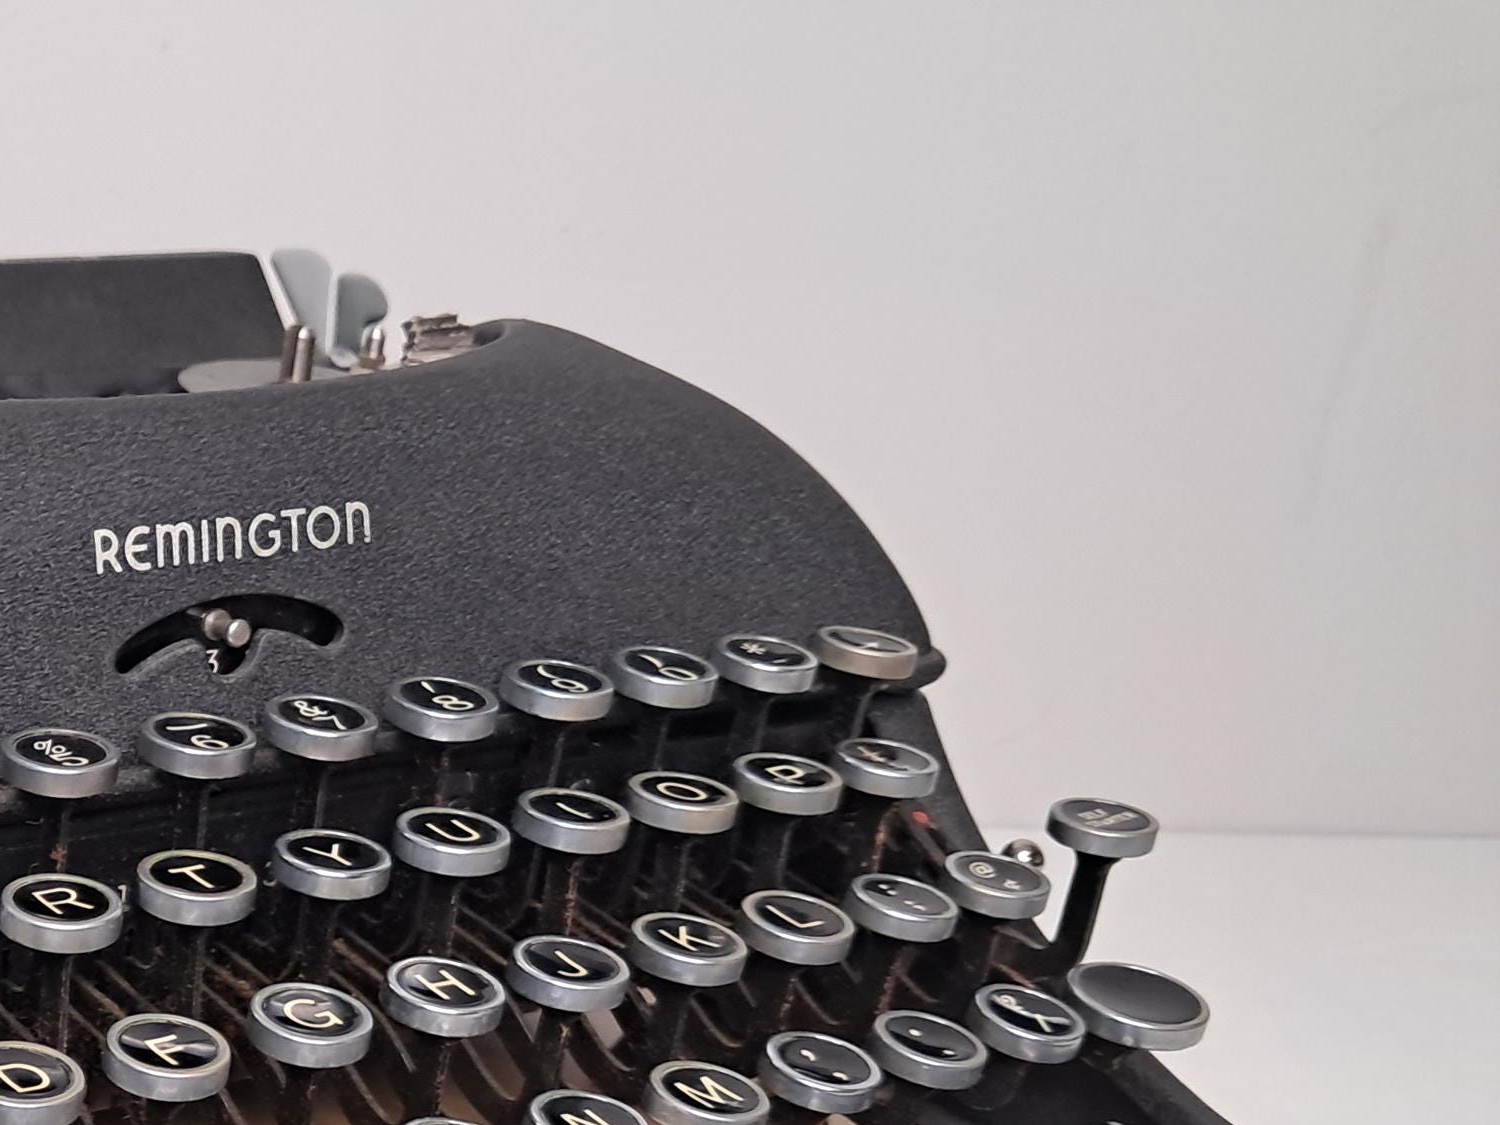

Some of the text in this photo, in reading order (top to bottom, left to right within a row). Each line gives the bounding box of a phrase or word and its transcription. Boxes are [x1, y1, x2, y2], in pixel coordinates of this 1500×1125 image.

[94, 500, 372, 574] REMINGTON
[549, 677, 589, 693] 9
[432, 694, 474, 711] 8
[312, 714, 348, 731] 7
[190, 734, 229, 750] 6
[764, 764, 808, 785] P
[655, 780, 708, 802] O
[424, 818, 481, 842] U
[303, 842, 354, 866] Y
[167, 863, 214, 889] T
[31, 886, 95, 915] R
[766, 904, 823, 929] L
[658, 924, 720, 951] K
[554, 950, 589, 979] J
[414, 970, 476, 1000] H
[282, 999, 343, 1028] G
[144, 1034, 185, 1066] F
[674, 1074, 745, 1109] M
